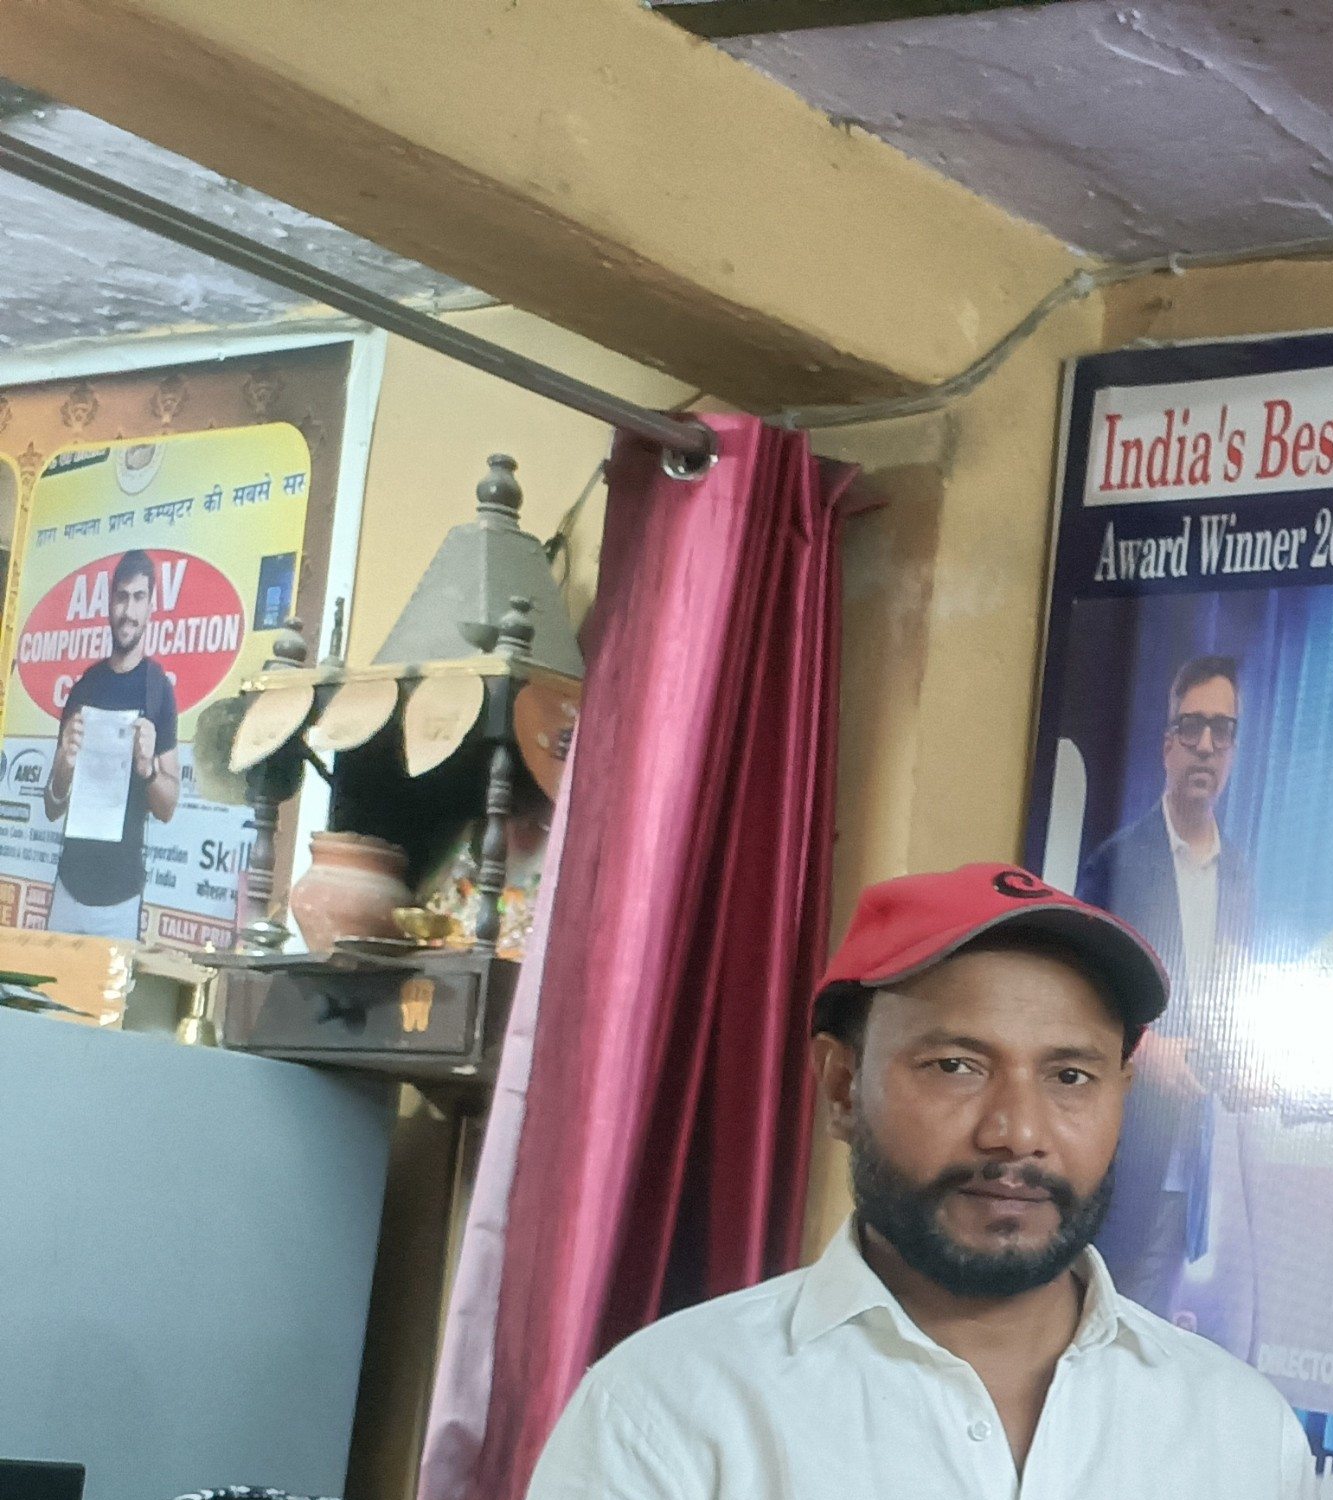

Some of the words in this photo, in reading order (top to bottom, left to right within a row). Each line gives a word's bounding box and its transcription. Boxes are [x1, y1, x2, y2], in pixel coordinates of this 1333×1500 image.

[1100, 404, 1245, 492] India's
[1095, 516, 1193, 582] Award
[1198, 510, 1306, 575] Winner
[66, 559, 188, 622] AAV
[146, 614, 240, 657] UCATION
